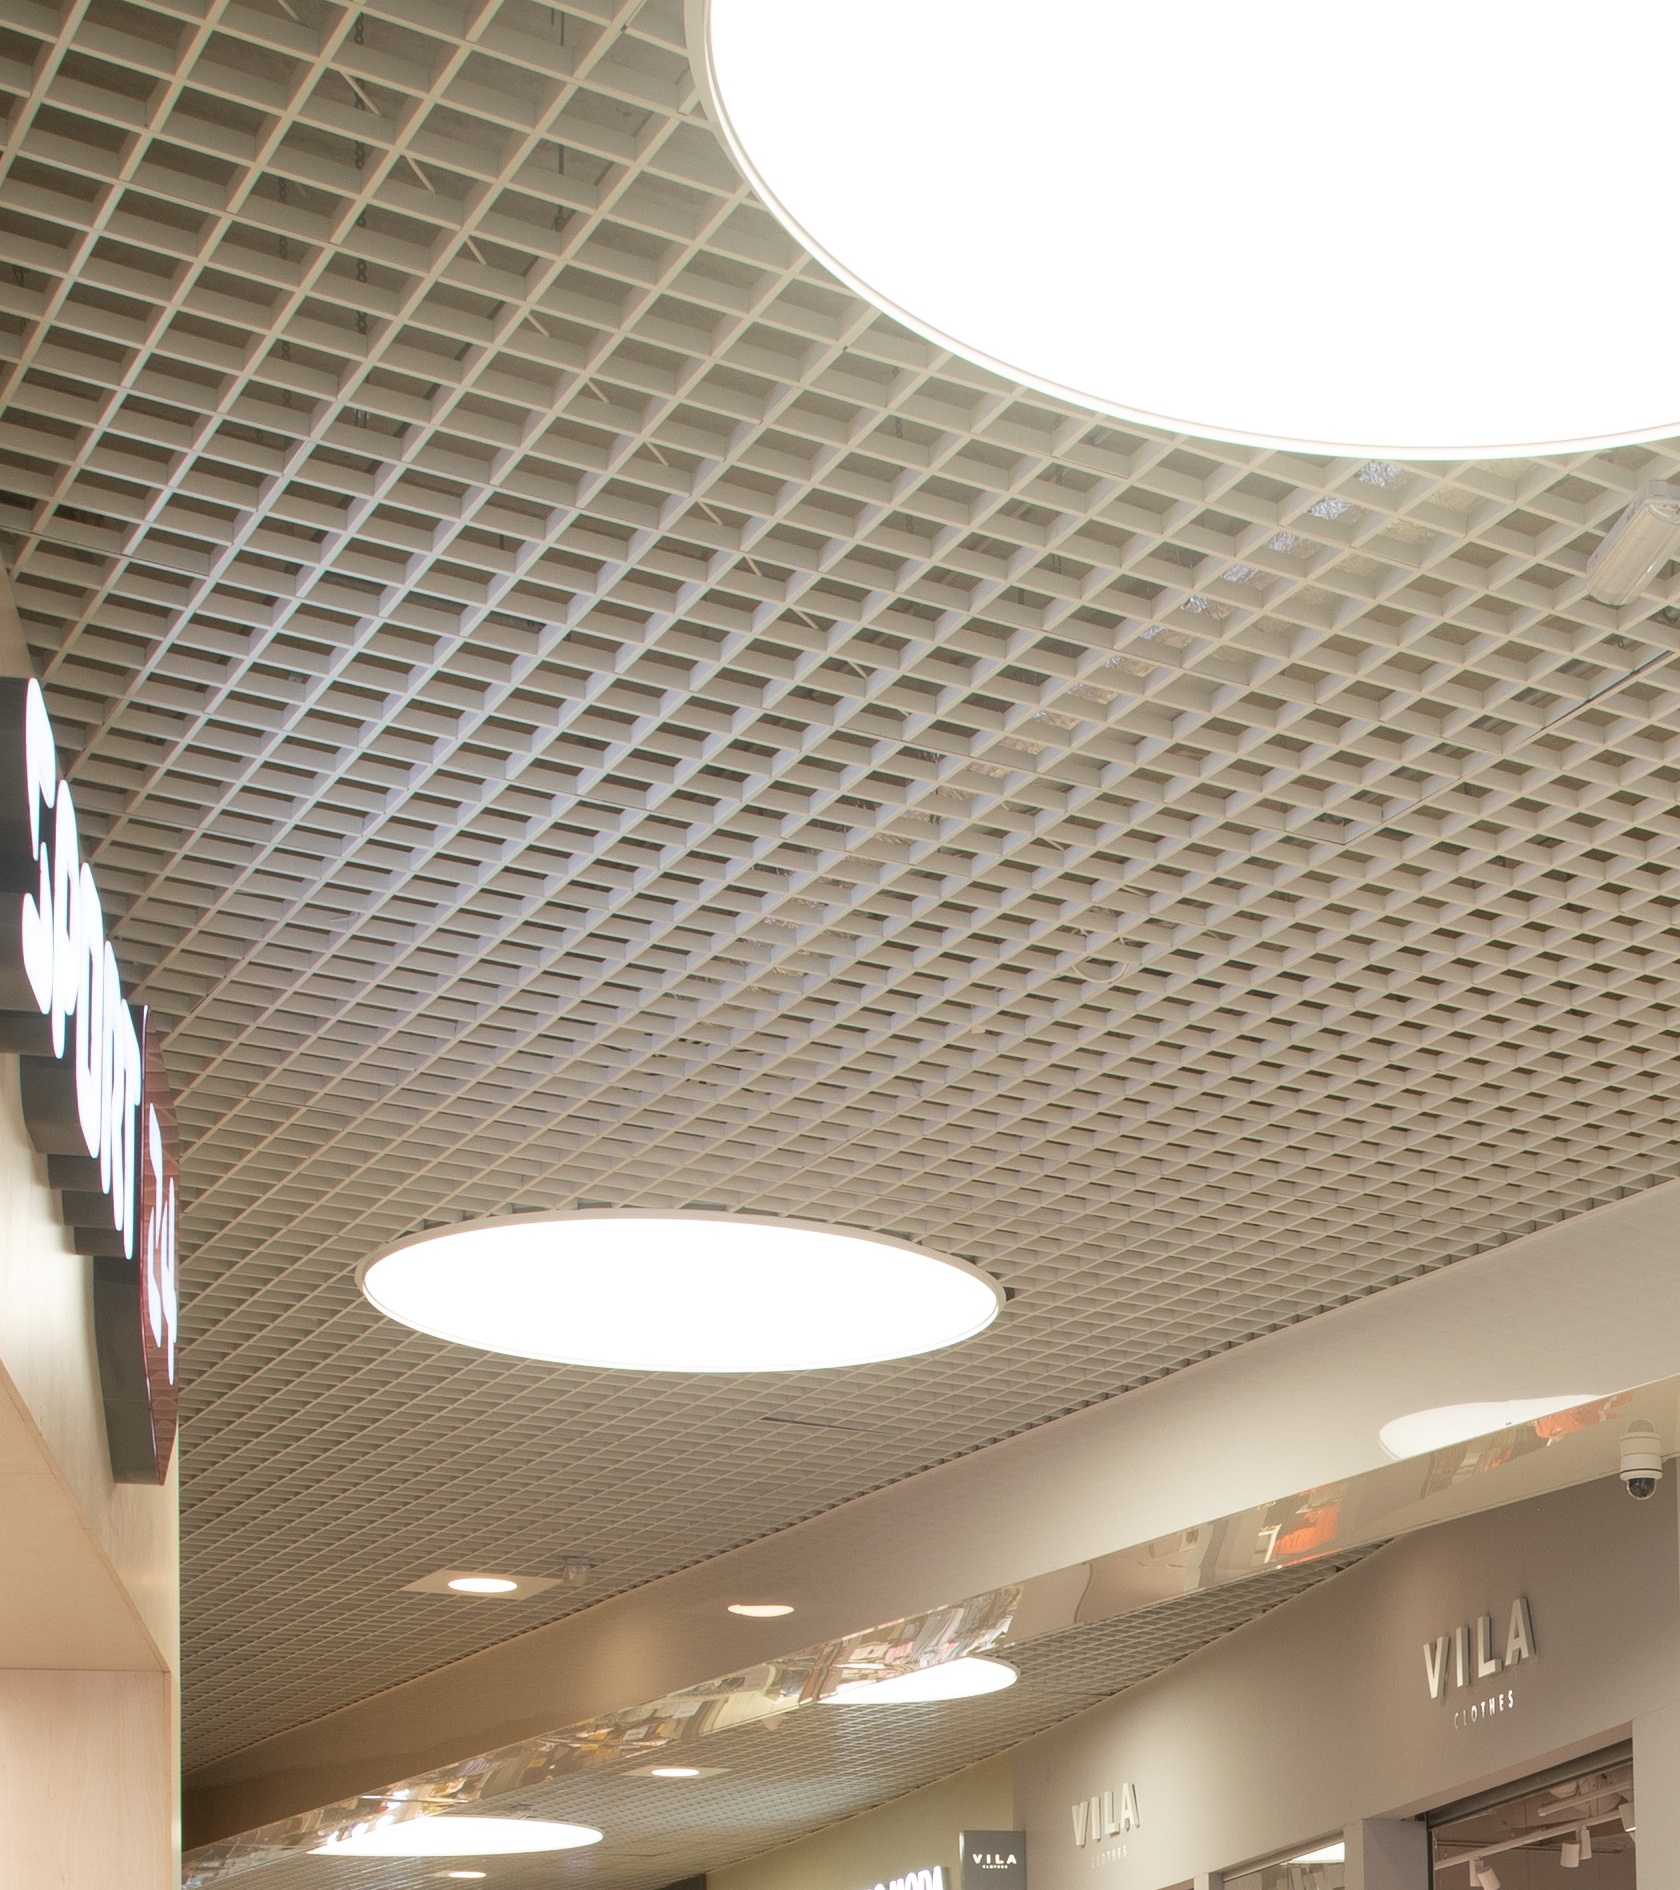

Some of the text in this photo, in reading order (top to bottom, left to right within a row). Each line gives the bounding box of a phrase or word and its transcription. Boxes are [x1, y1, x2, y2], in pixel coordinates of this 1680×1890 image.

[1423, 1598, 1536, 1699] VILA
[1454, 1689, 1514, 1730] CLOTHES
[1072, 1782, 1140, 1847] VILA
[972, 1854, 1017, 1865] VILA
